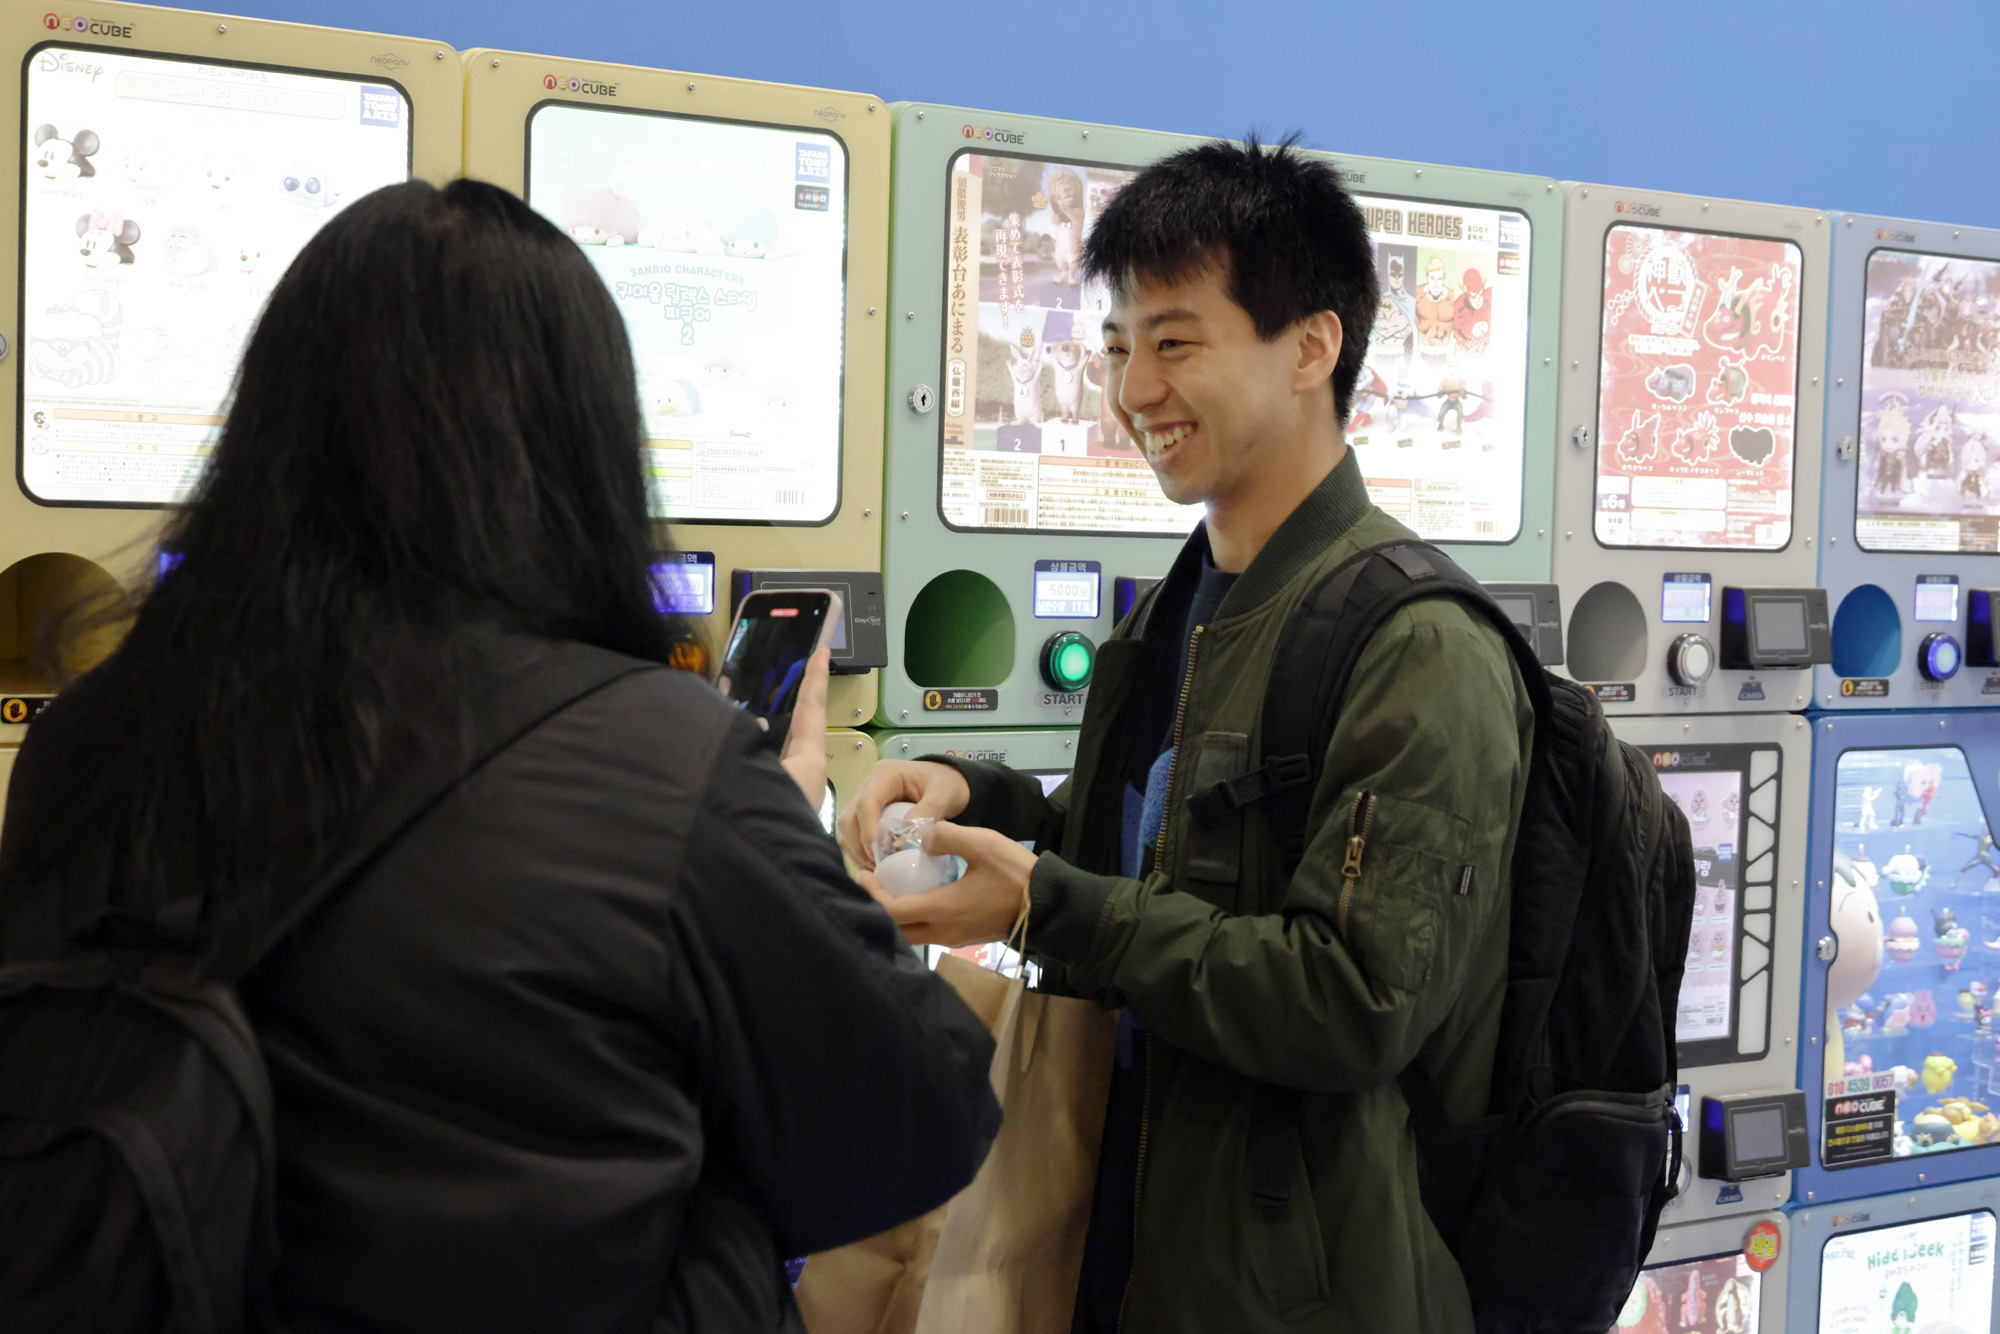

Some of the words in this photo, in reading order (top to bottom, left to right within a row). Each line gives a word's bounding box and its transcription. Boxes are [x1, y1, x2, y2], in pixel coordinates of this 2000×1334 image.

[90, 23, 132, 39] CUBE
[36, 50, 103, 83] Disney
[582, 83, 617, 97] CUBE
[363, 101, 398, 113] TOMY
[994, 132, 1025, 145] CUBE
[798, 157, 828, 168] TOMY
[1638, 206, 1660, 217] CUBE
[1407, 209, 1463, 240] HEROES
[1008, 212, 1025, 313] 集めて表彰式を
[630, 264, 671, 277] SANRIO
[675, 264, 745, 286] CHARACTERS
[616, 281, 662, 305] 귀여운
[664, 282, 711, 306] 릴렉스
[714, 287, 758, 312] 스타일
[951, 225, 969, 354] 表彰台あにまる
[1056, 296, 1063, 309] 2
[664, 305, 711, 325] 피규어
[681, 325, 695, 346] 2
[1014, 438, 1021, 451] 2
[1060, 439, 1065, 451] 1
[1050, 562, 1086, 573] 상품금액
[1668, 687, 1698, 696] START
[1043, 694, 1084, 705] START
[1681, 754, 1706, 766] CUBE
[1828, 1080, 1845, 1096] 010
[1859, 1099, 1885, 1113] CUBE
[1750, 1233, 1776, 1259] 세일
[1867, 1247, 1899, 1270] Hide
